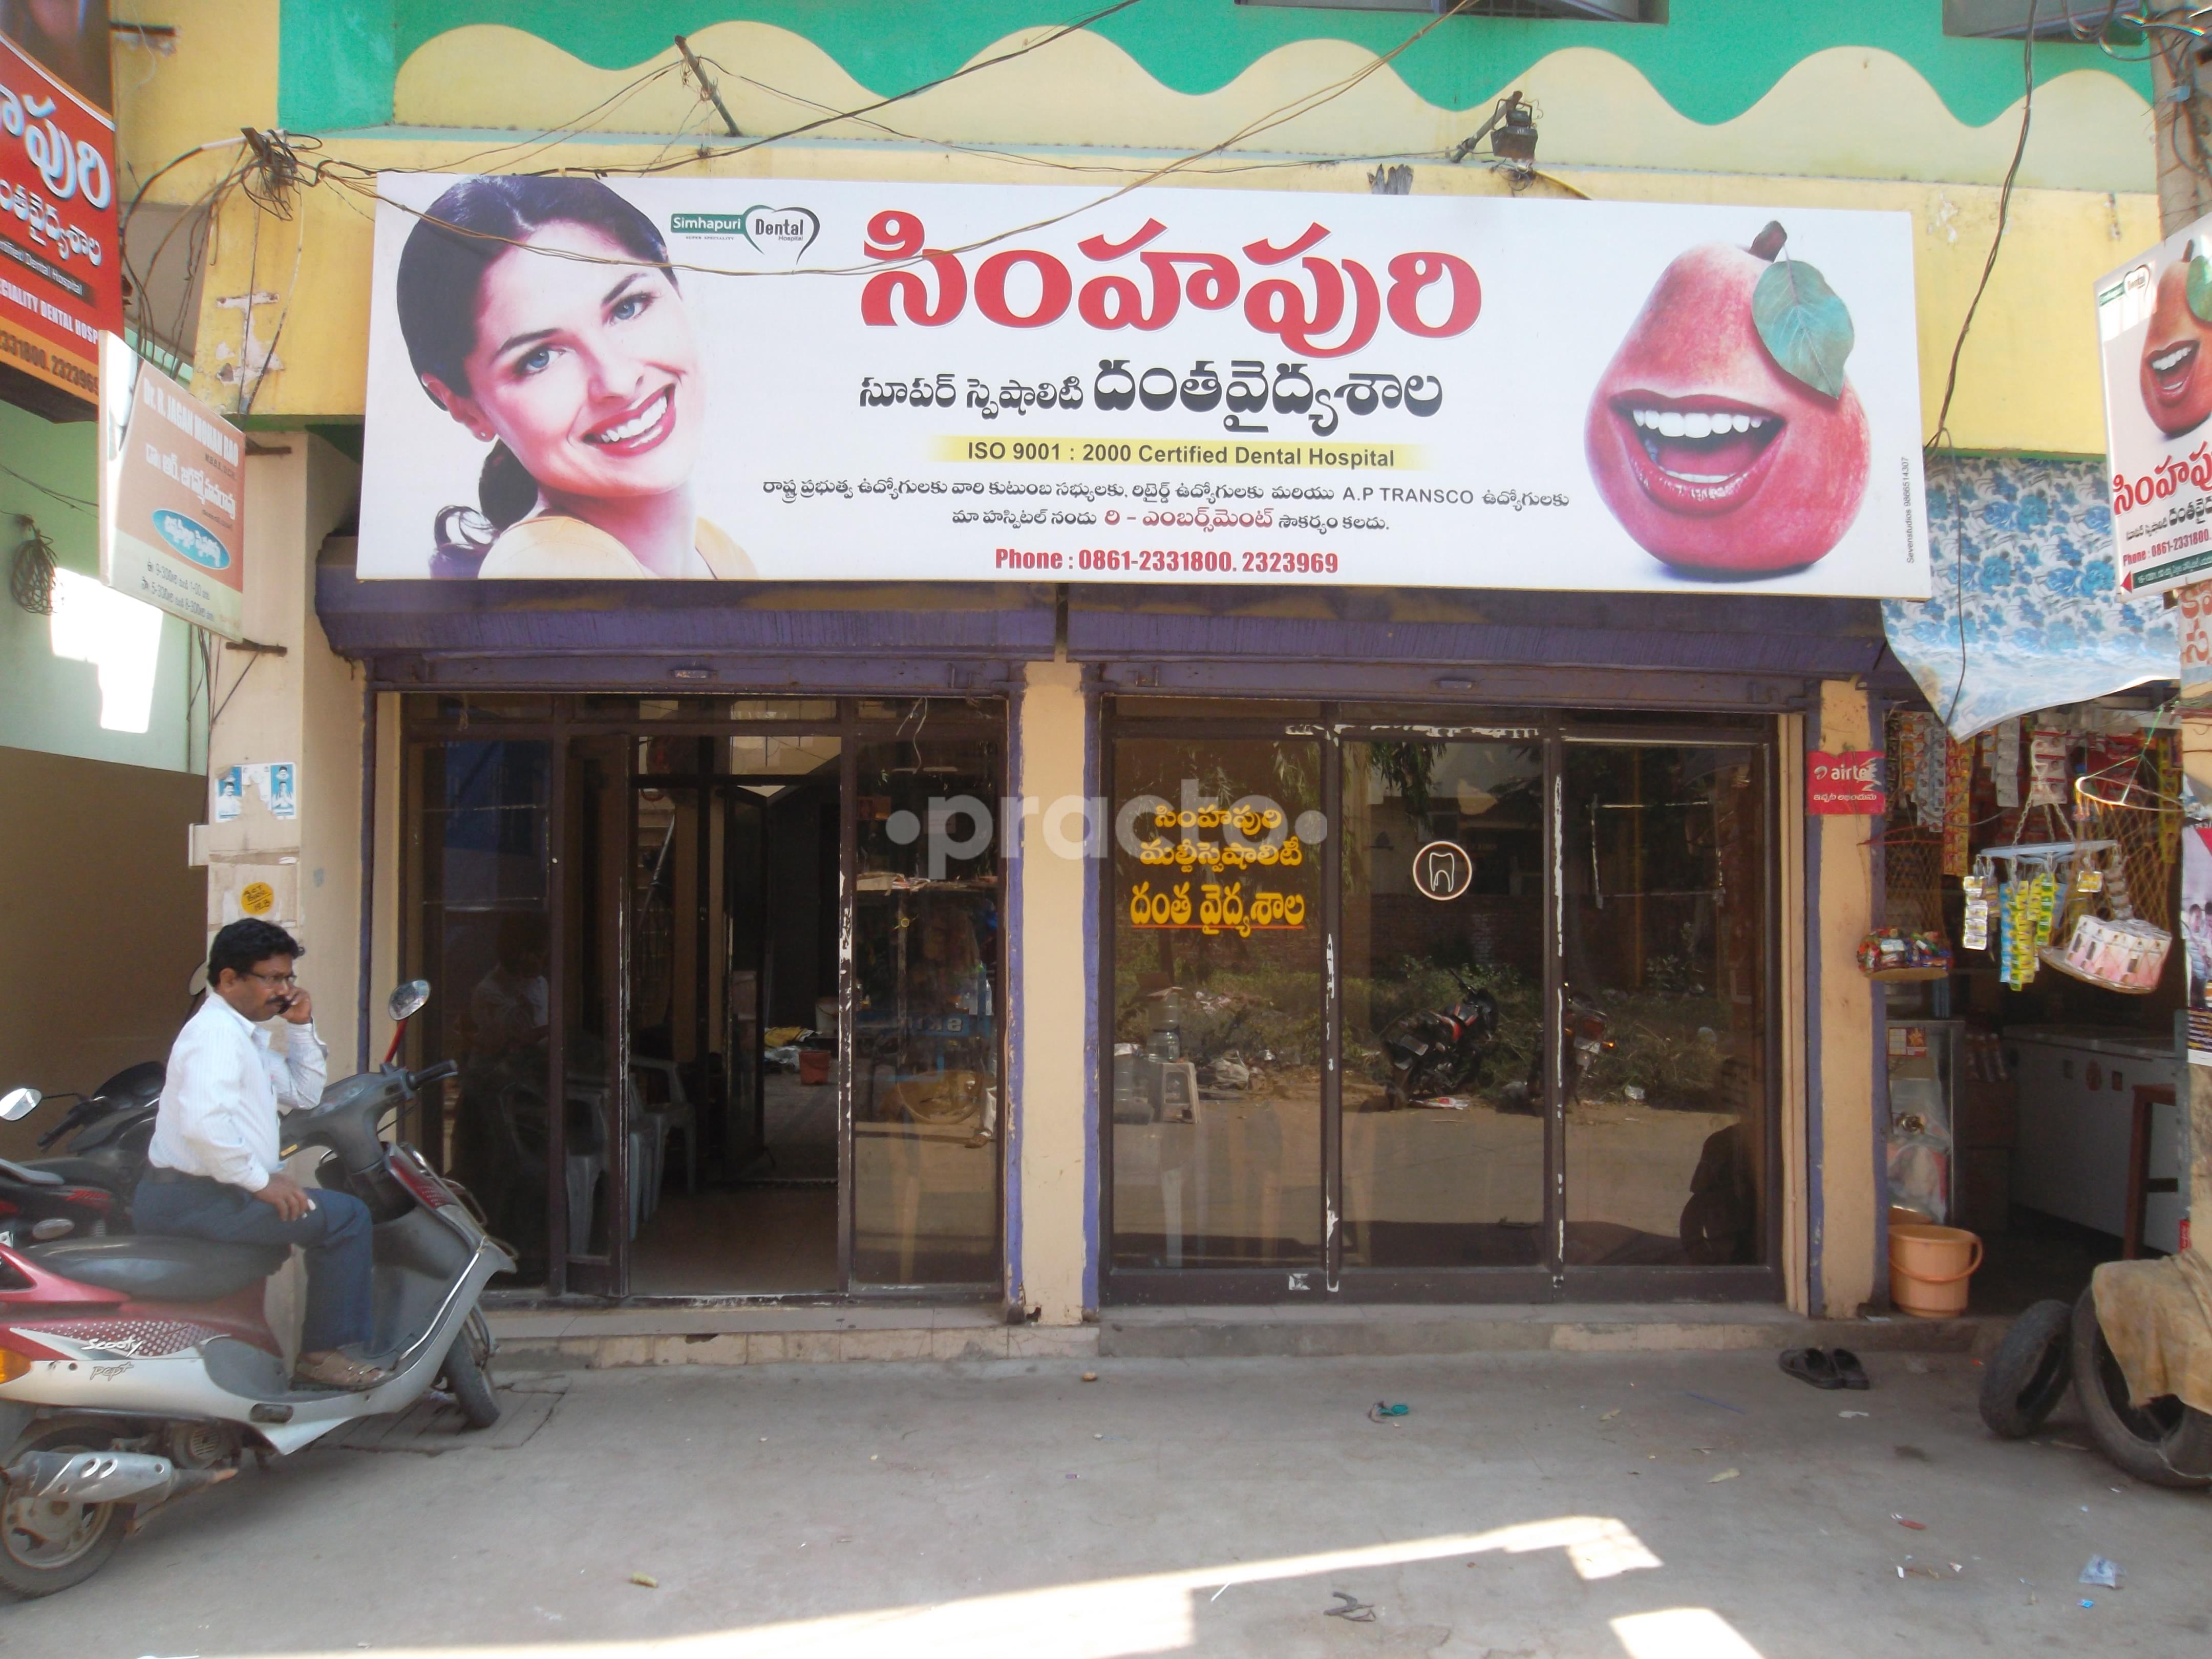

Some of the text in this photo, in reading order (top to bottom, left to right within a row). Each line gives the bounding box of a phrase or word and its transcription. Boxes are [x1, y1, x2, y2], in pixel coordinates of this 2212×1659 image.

[673, 217, 803, 236] Simhapuri Dental
[40, 299, 74, 332] DENTAL
[860, 374, 956, 408] సూపర్
[1094, 355, 1443, 437] దంతవైద్యశాల
[968, 442, 1394, 469] ISO 9001 : 2000 Certified Dental Hospital
[801, 480, 854, 499] ప్రభుత్వ
[858, 480, 948, 500] ఉద్యోగులకు
[952, 483, 985, 495] వారి
[989, 482, 1052, 496] కుటుంబ
[1177, 484, 1264, 505] ఉద్యోగులకు
[1272, 486, 1335, 500] మరియు
[1344, 487, 1374, 500] A.P
[1380, 488, 1474, 504] TRANSCO
[1481, 490, 1570, 512] ఉద్యోగులకు
[953, 511, 980, 524] మా
[1052, 514, 1097, 525] నందు
[1901, 456, 1914, 564] Sevenstudios 9866514307
[996, 548, 1063, 568] Phone
[1079, 549, 1238, 572] 0861-2331800.
[1245, 552, 1338, 572] 2323969
[2122, 550, 2146, 566] Phone
[1831, 764, 1876, 780] airte
[1130, 881, 1192, 925] దంత
[80, 1335, 143, 1358] Scooty
